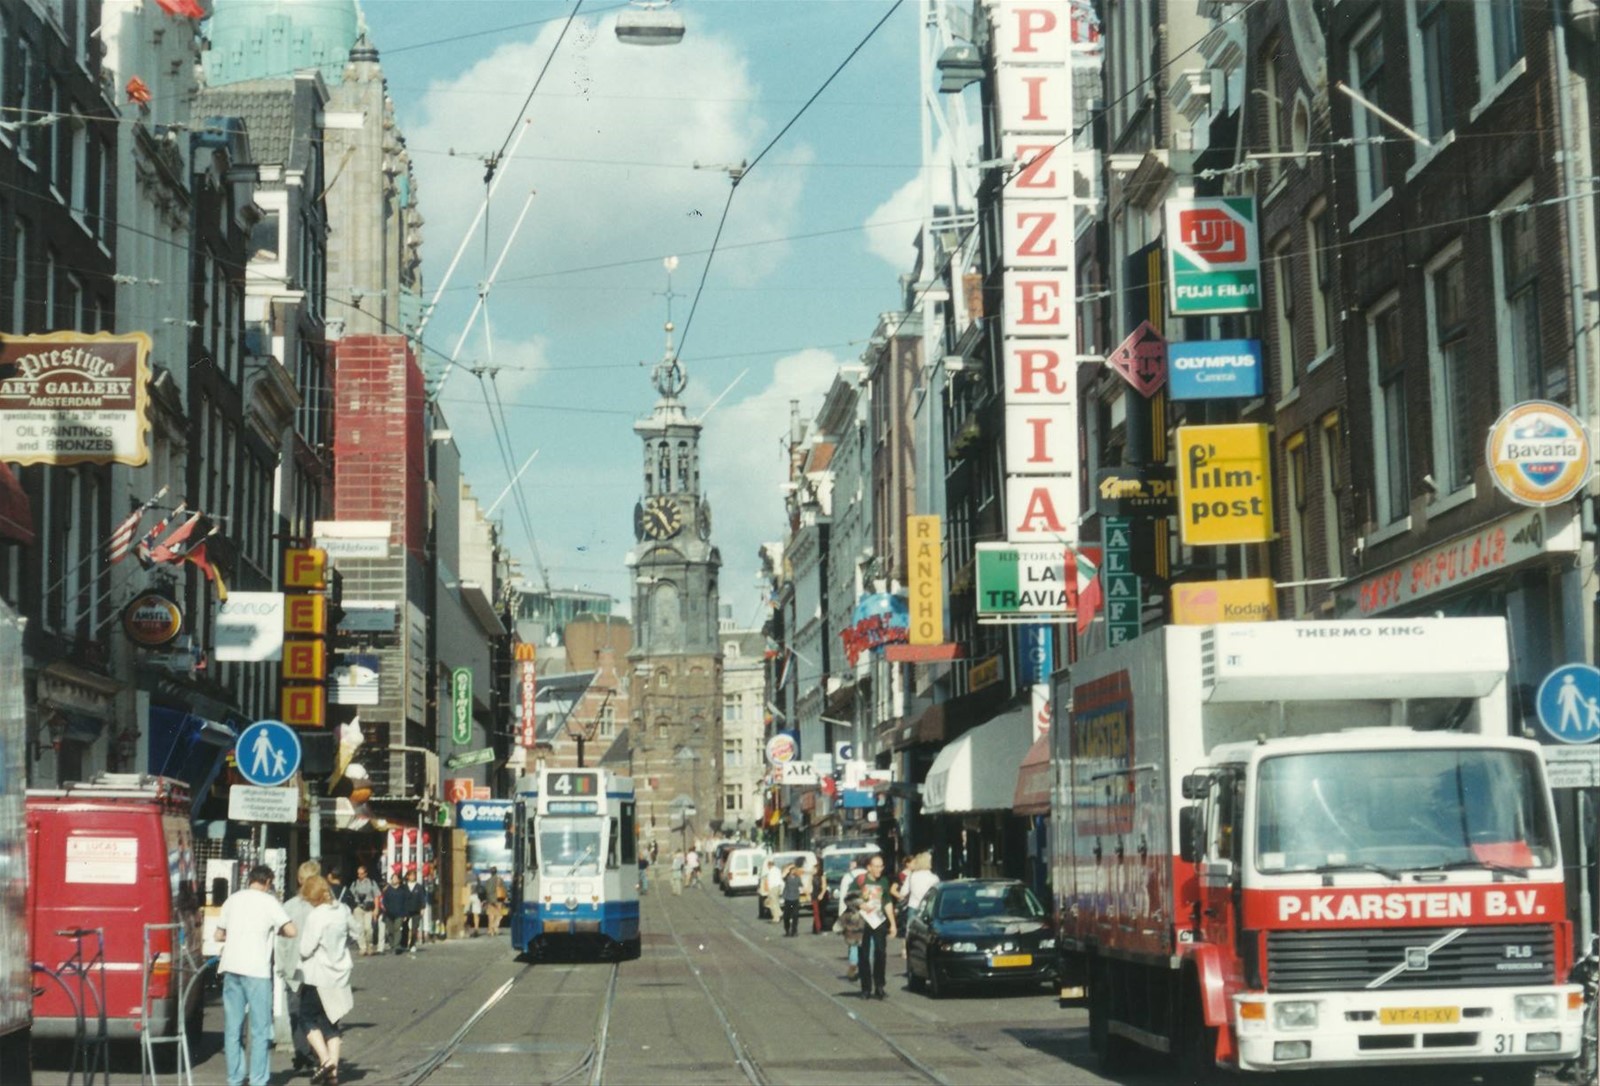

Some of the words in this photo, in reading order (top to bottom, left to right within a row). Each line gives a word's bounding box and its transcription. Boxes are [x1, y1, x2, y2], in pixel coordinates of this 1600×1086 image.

[1011, 8, 1067, 532] PIZZERIA
[1177, 285, 1213, 298] FUJI
[1218, 284, 1255, 296] FILM
[16, 347, 115, 380] Prestige
[1175, 354, 1256, 370] OLYMPUS
[1, 382, 39, 394] ART
[45, 382, 132, 394] GALLERY
[29, 397, 103, 407] AMSTERDAM
[16, 426, 38, 437] OIL
[41, 426, 113, 437] PAINTINGS
[16, 442, 39, 450] and
[46, 440, 113, 451] BRONZES
[1507, 443, 1577, 459] Bavaria
[1192, 496, 1264, 525] post
[916, 521, 934, 640] RANCHO
[1027, 566, 1056, 582] LA
[1223, 602, 1272, 617] Kodak
[289, 554, 315, 721] FEBO
[1296, 627, 1372, 638] THERMO
[1378, 625, 1425, 636] KING
[554, 775, 572, 795] 4
[1278, 893, 1472, 921] P.KARSTEN
[1485, 890, 1546, 917] B.V.
[1494, 1034, 1515, 1053] 31
